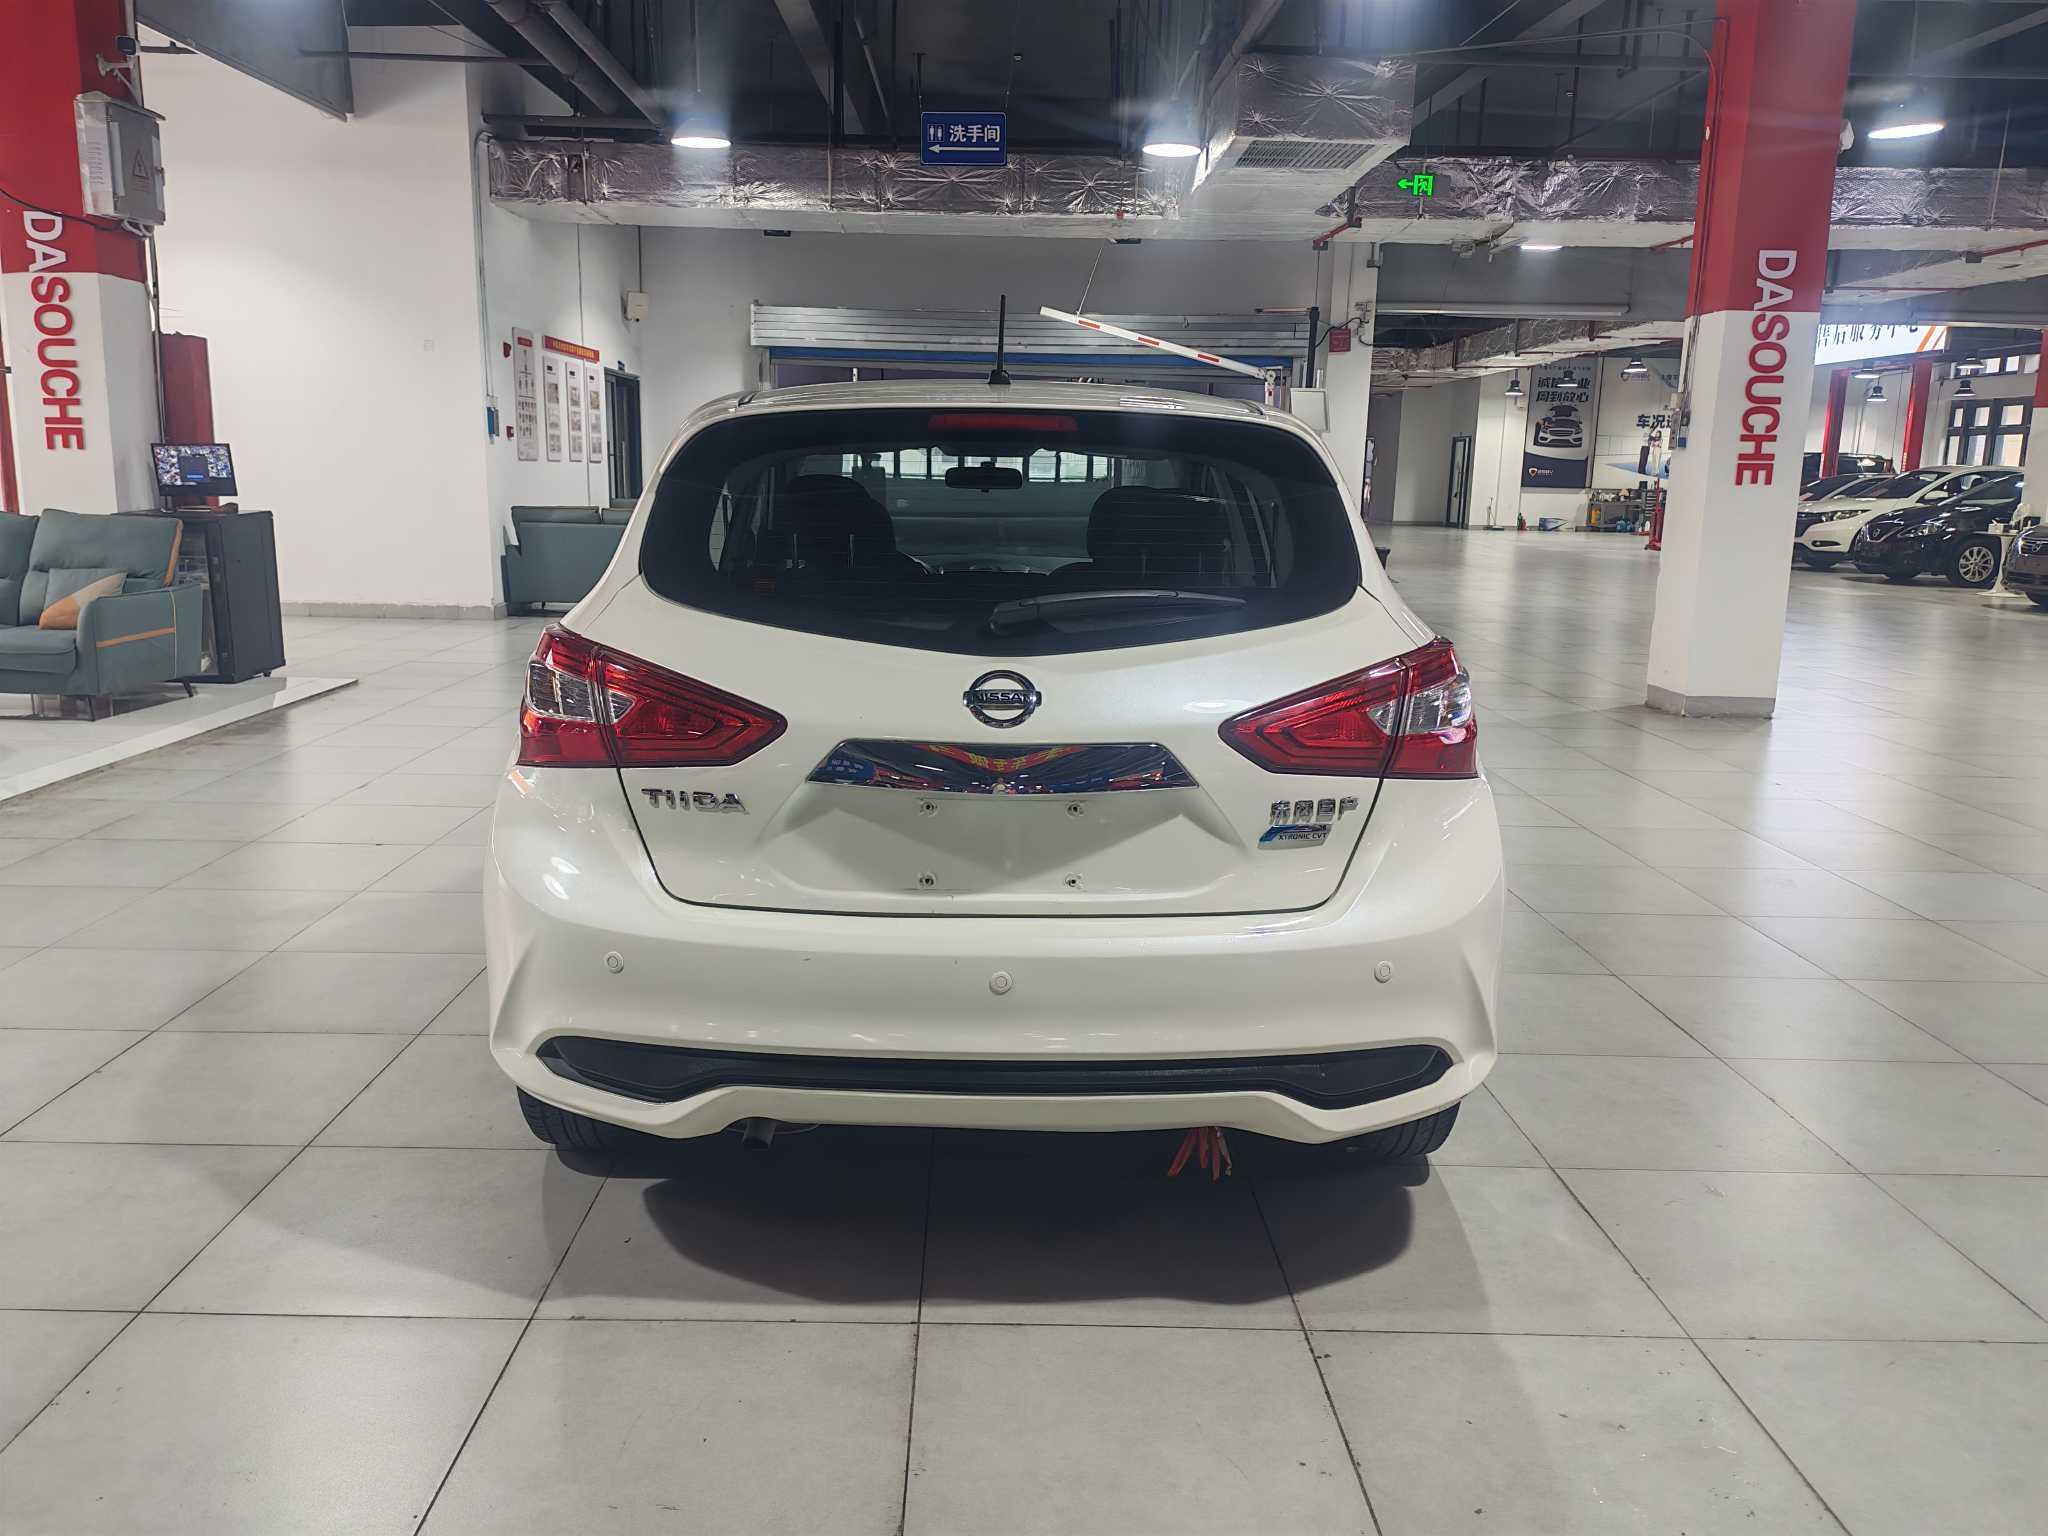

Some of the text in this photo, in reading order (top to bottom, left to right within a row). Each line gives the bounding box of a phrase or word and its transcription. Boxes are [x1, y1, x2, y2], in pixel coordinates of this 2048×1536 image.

[949, 124, 1001, 143] 洗手间
[22, 210, 87, 452] DASOUCHE
[1736, 248, 1798, 487] DASOUCHE
[1535, 391, 1590, 403] 周到放心
[640, 788, 750, 815] TIIDA
[1278, 832, 1328, 841] XTRONIC CVT
